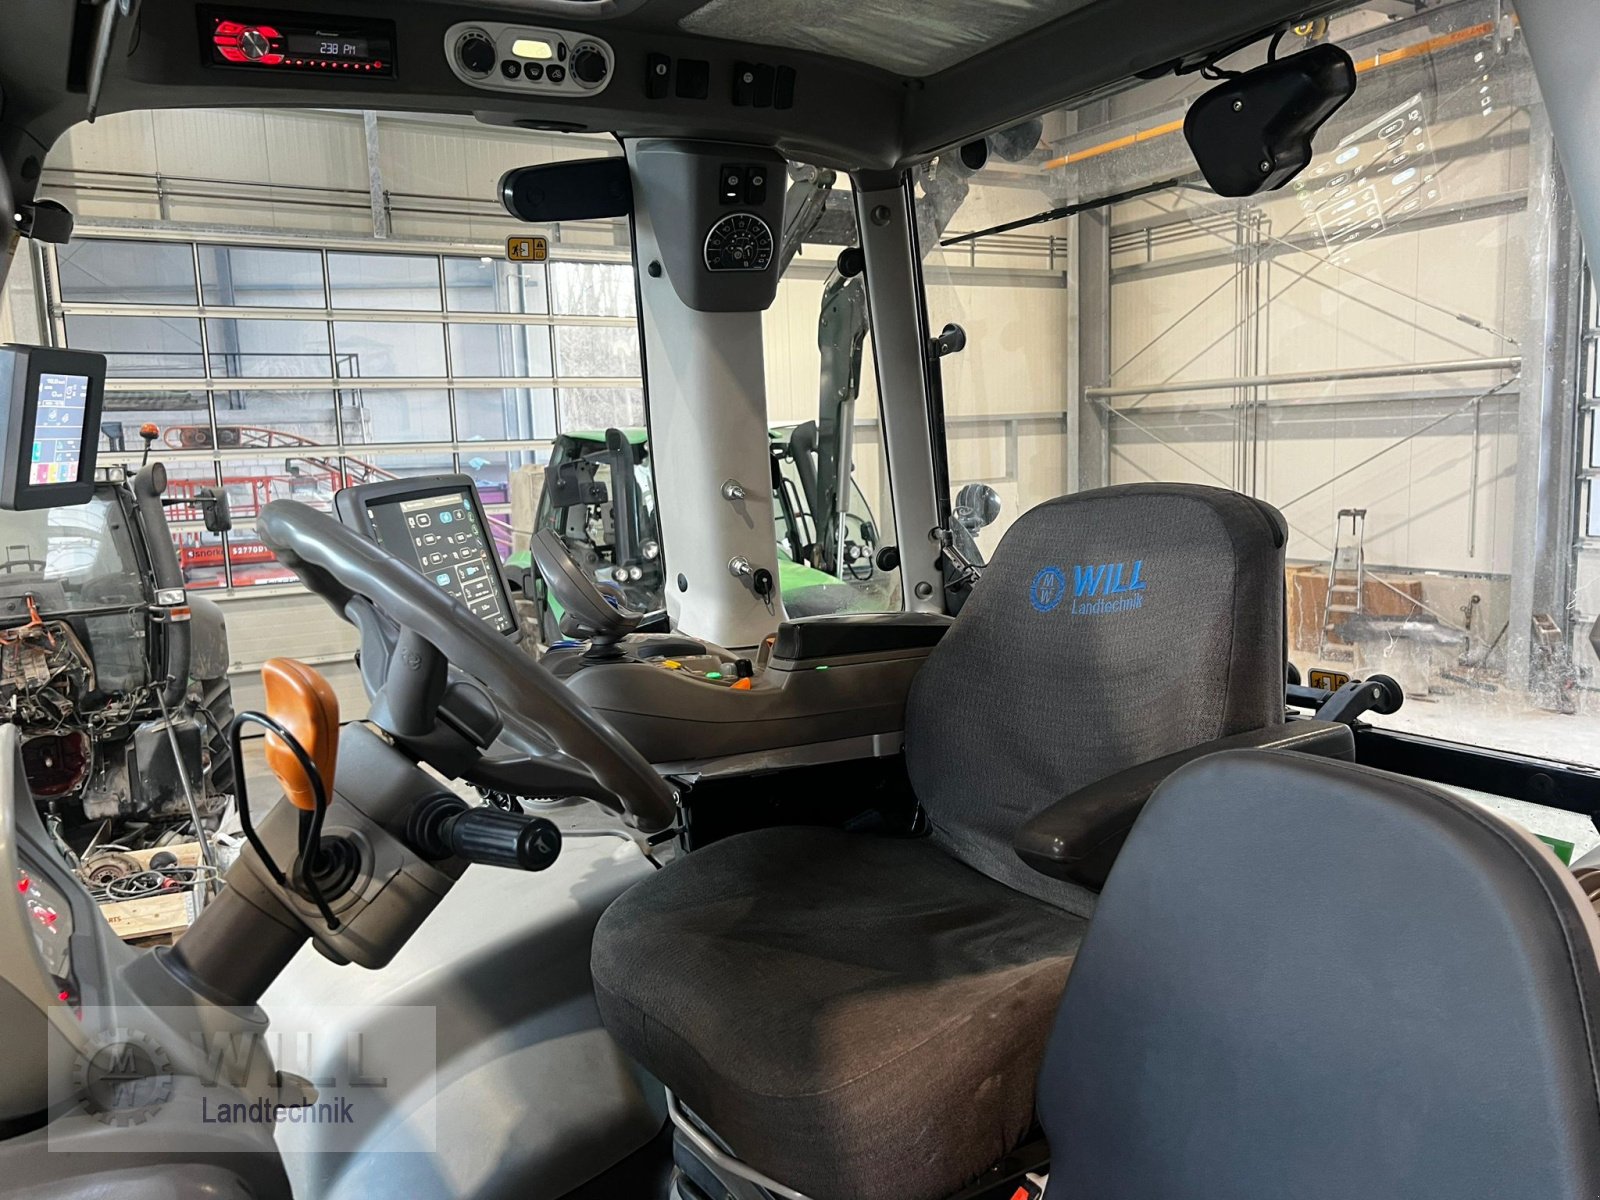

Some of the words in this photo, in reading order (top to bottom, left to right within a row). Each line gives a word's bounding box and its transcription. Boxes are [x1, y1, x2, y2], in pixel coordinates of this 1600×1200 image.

[343, 44, 356, 55] PM
[194, 549, 225, 558] snork
[1073, 560, 1147, 597] WILL
[1071, 593, 1144, 615] Landtechnik
